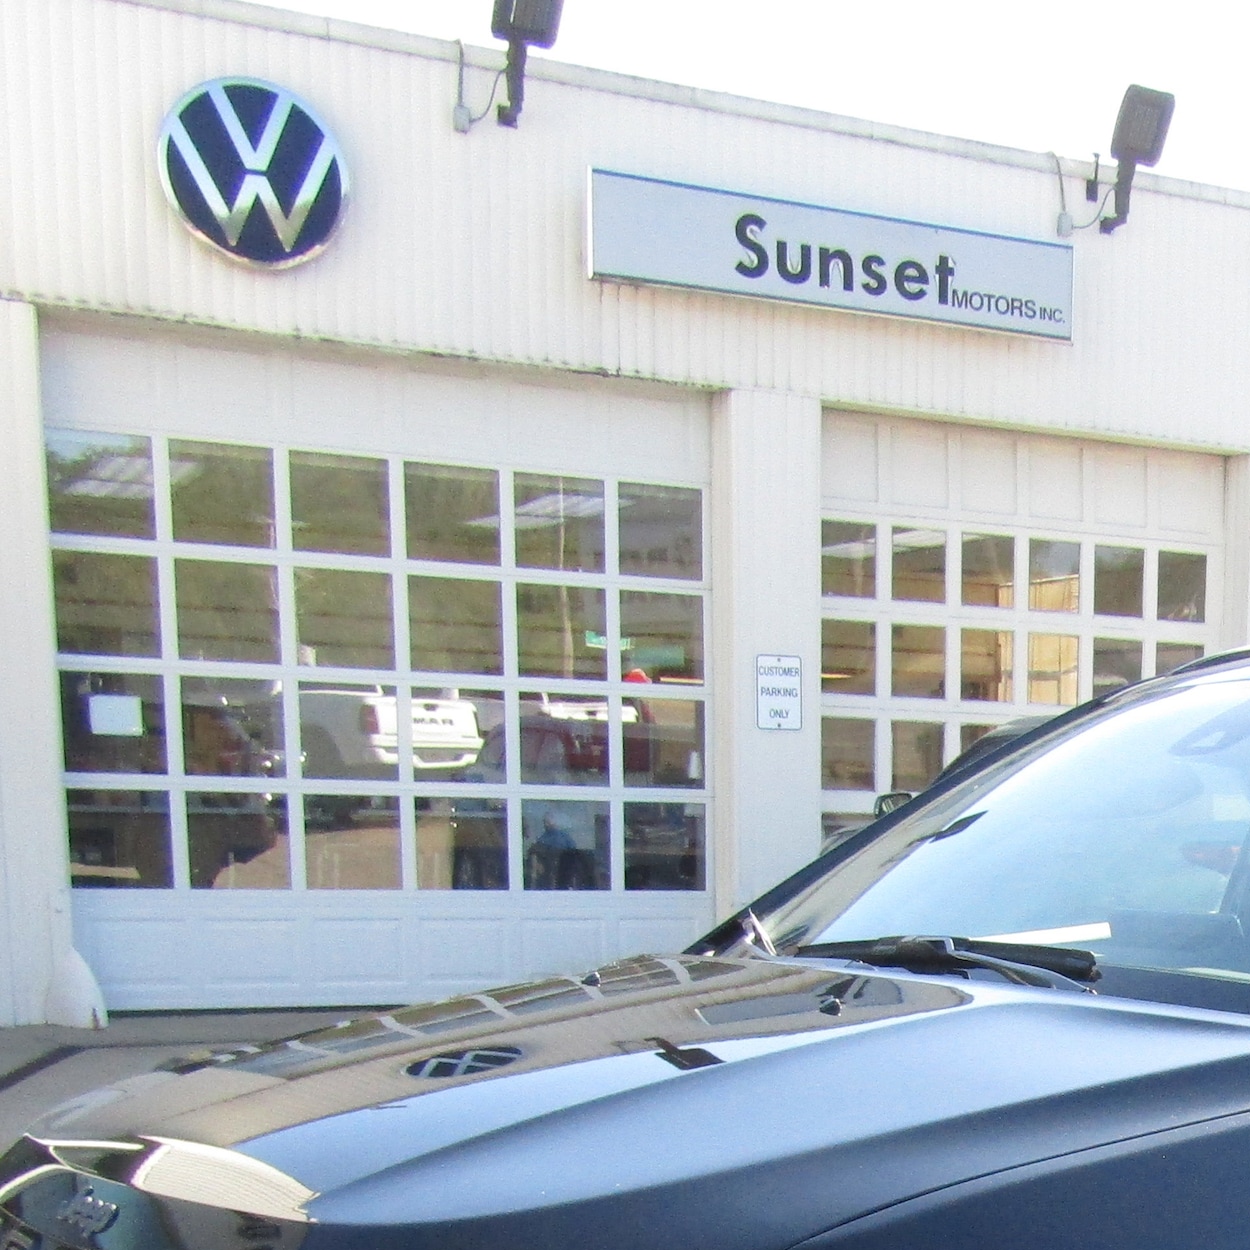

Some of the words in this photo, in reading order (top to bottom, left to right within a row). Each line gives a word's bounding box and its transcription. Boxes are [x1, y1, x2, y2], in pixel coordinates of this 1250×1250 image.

[160, 78, 348, 259] VW
[735, 213, 955, 306] Sunset
[952, 288, 1037, 320] MOTORS
[1039, 306, 1066, 324] INC.
[758, 666, 800, 677] CUSTOMER
[760, 687, 798, 698] PARKING
[769, 708, 790, 719] ONLY
